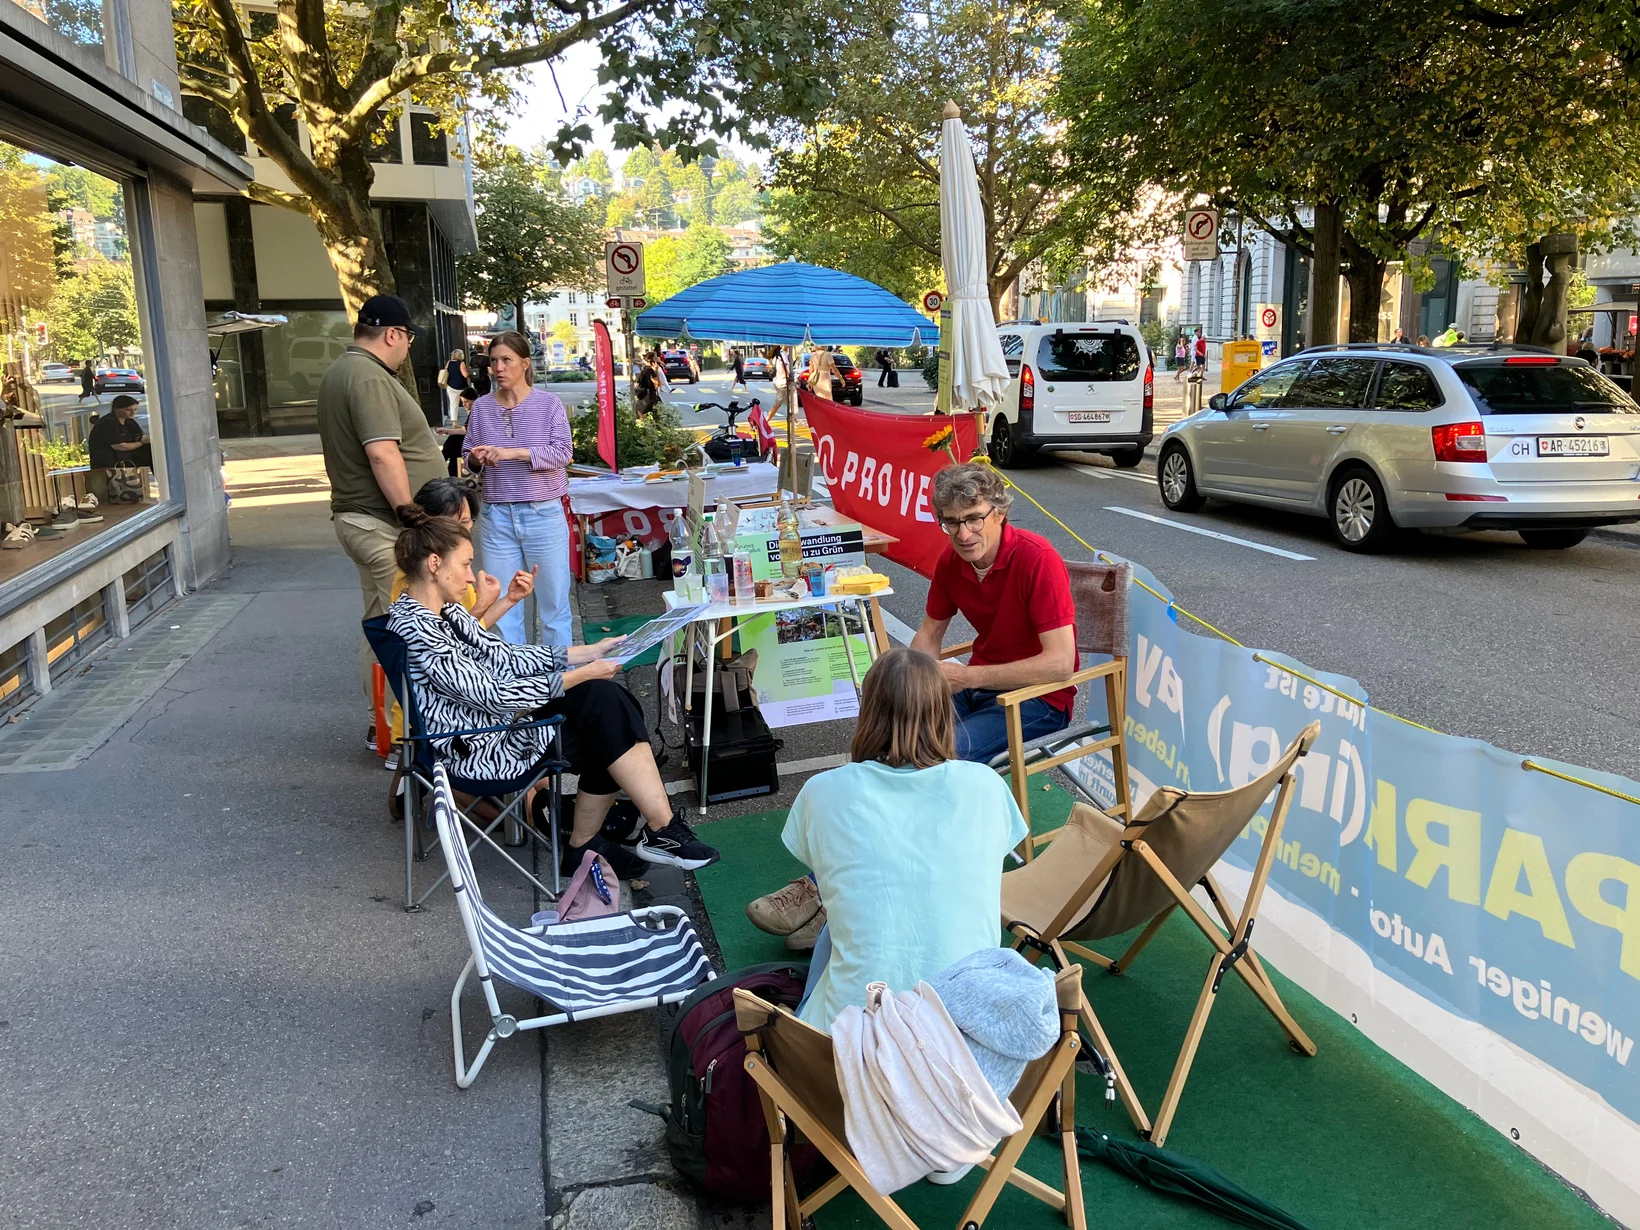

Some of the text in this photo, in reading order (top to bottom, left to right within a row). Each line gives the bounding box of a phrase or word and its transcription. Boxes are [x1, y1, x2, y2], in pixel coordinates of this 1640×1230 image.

[929, 298, 938, 306] 30
[1511, 443, 1530, 456] CH
[841, 450, 935, 523] PRO VE
[801, 534, 842, 546] wandlung
[810, 548, 820, 557] zu
[821, 545, 843, 556] Grün
